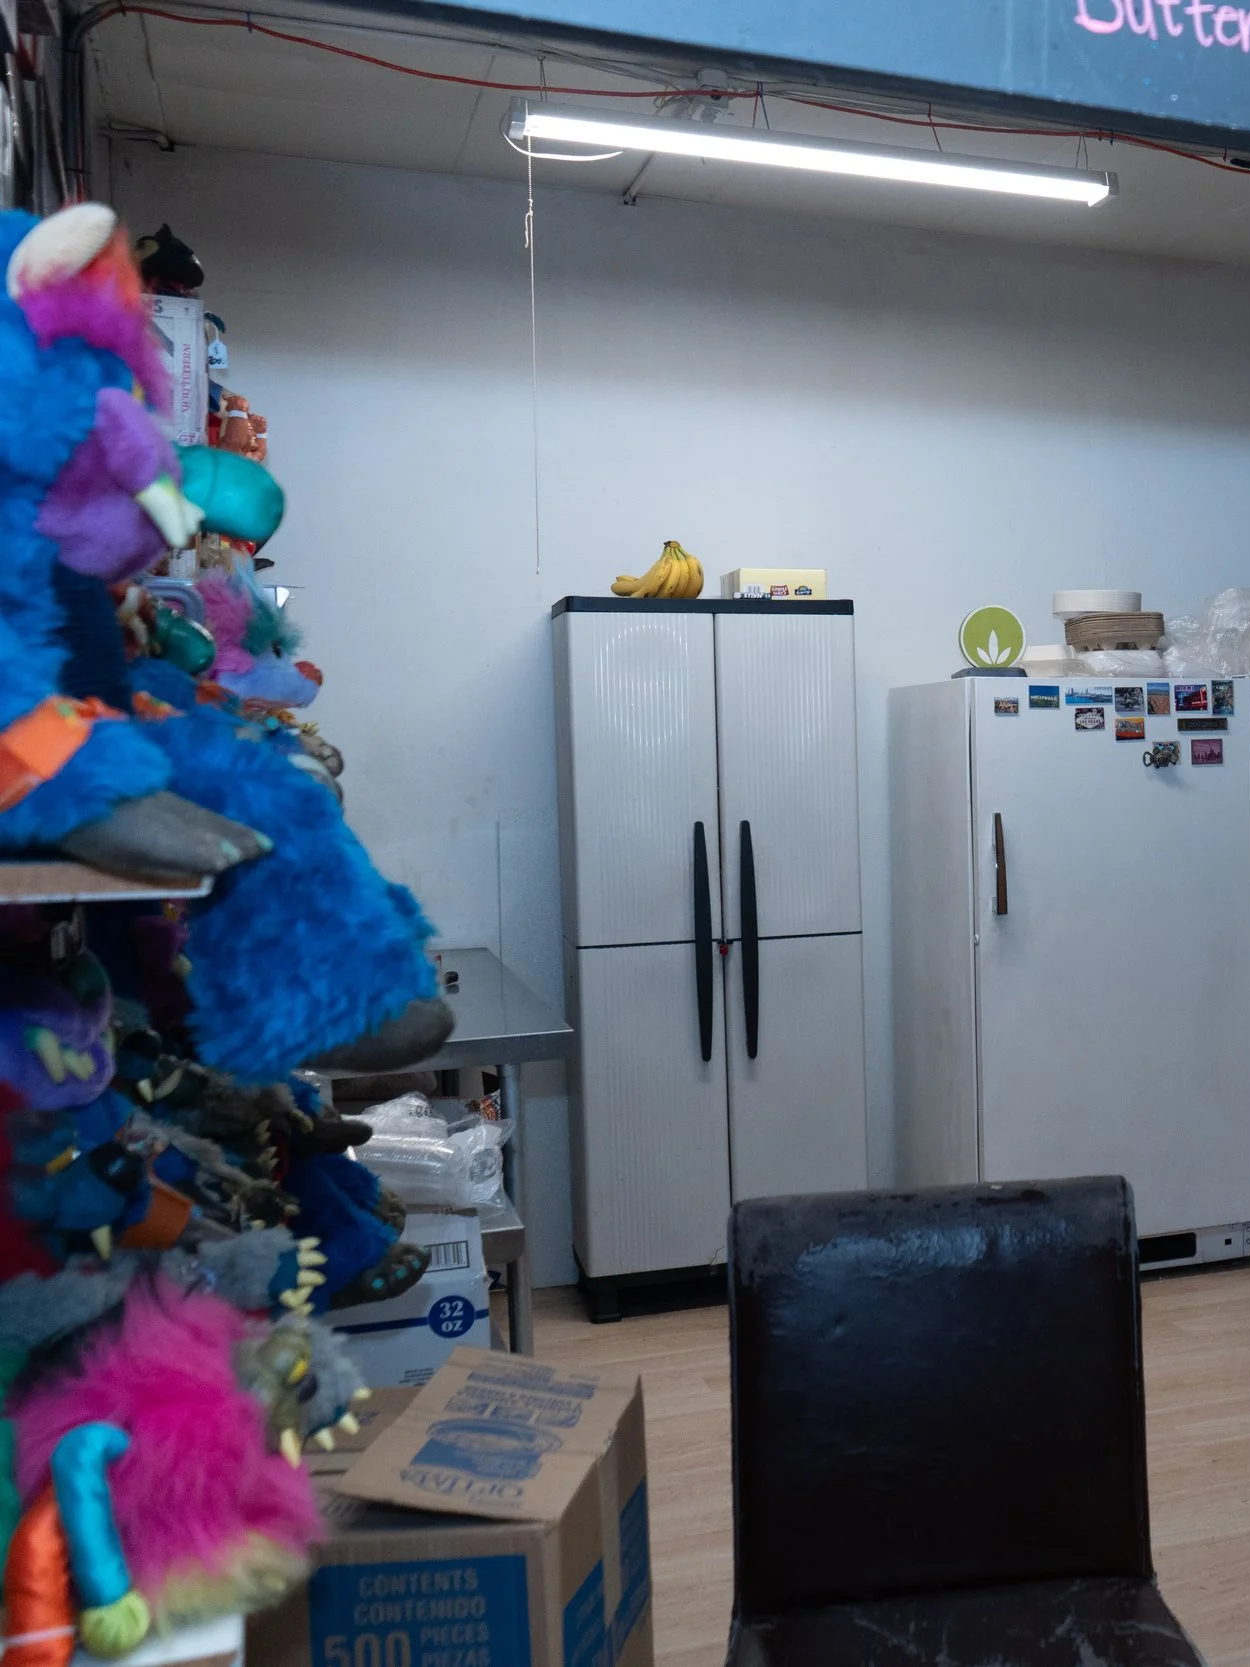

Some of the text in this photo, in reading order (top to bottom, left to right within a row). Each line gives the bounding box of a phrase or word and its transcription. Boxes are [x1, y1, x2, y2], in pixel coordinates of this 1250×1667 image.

[440, 1300, 464, 1319] 32
[358, 1567, 479, 1599] CONTENTS
[353, 1594, 488, 1627] CONTENIDO
[323, 1627, 414, 1667] 500
[419, 1620, 491, 1649] PIECES
